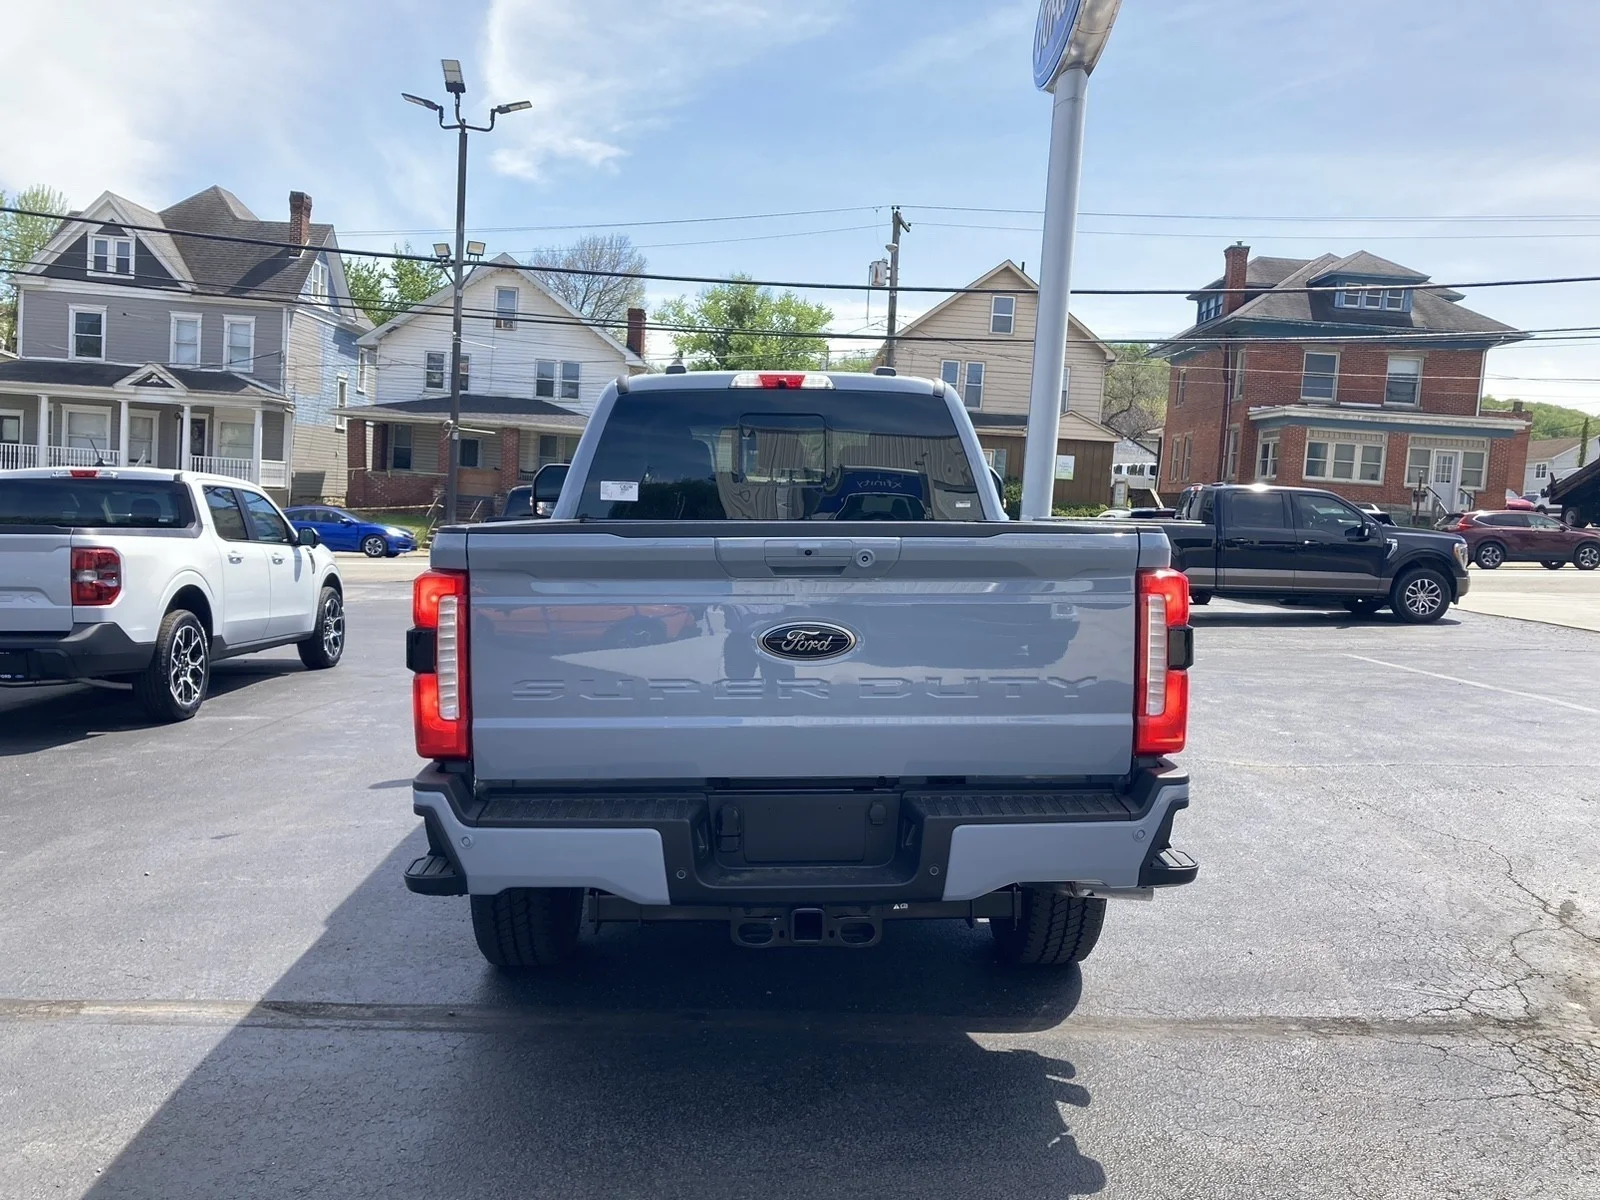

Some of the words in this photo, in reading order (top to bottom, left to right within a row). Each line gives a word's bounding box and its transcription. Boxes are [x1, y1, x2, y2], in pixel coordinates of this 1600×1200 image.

[781, 629, 833, 652] Ford
[512, 677, 830, 701] SUPER
[858, 675, 1098, 700] DUTY
